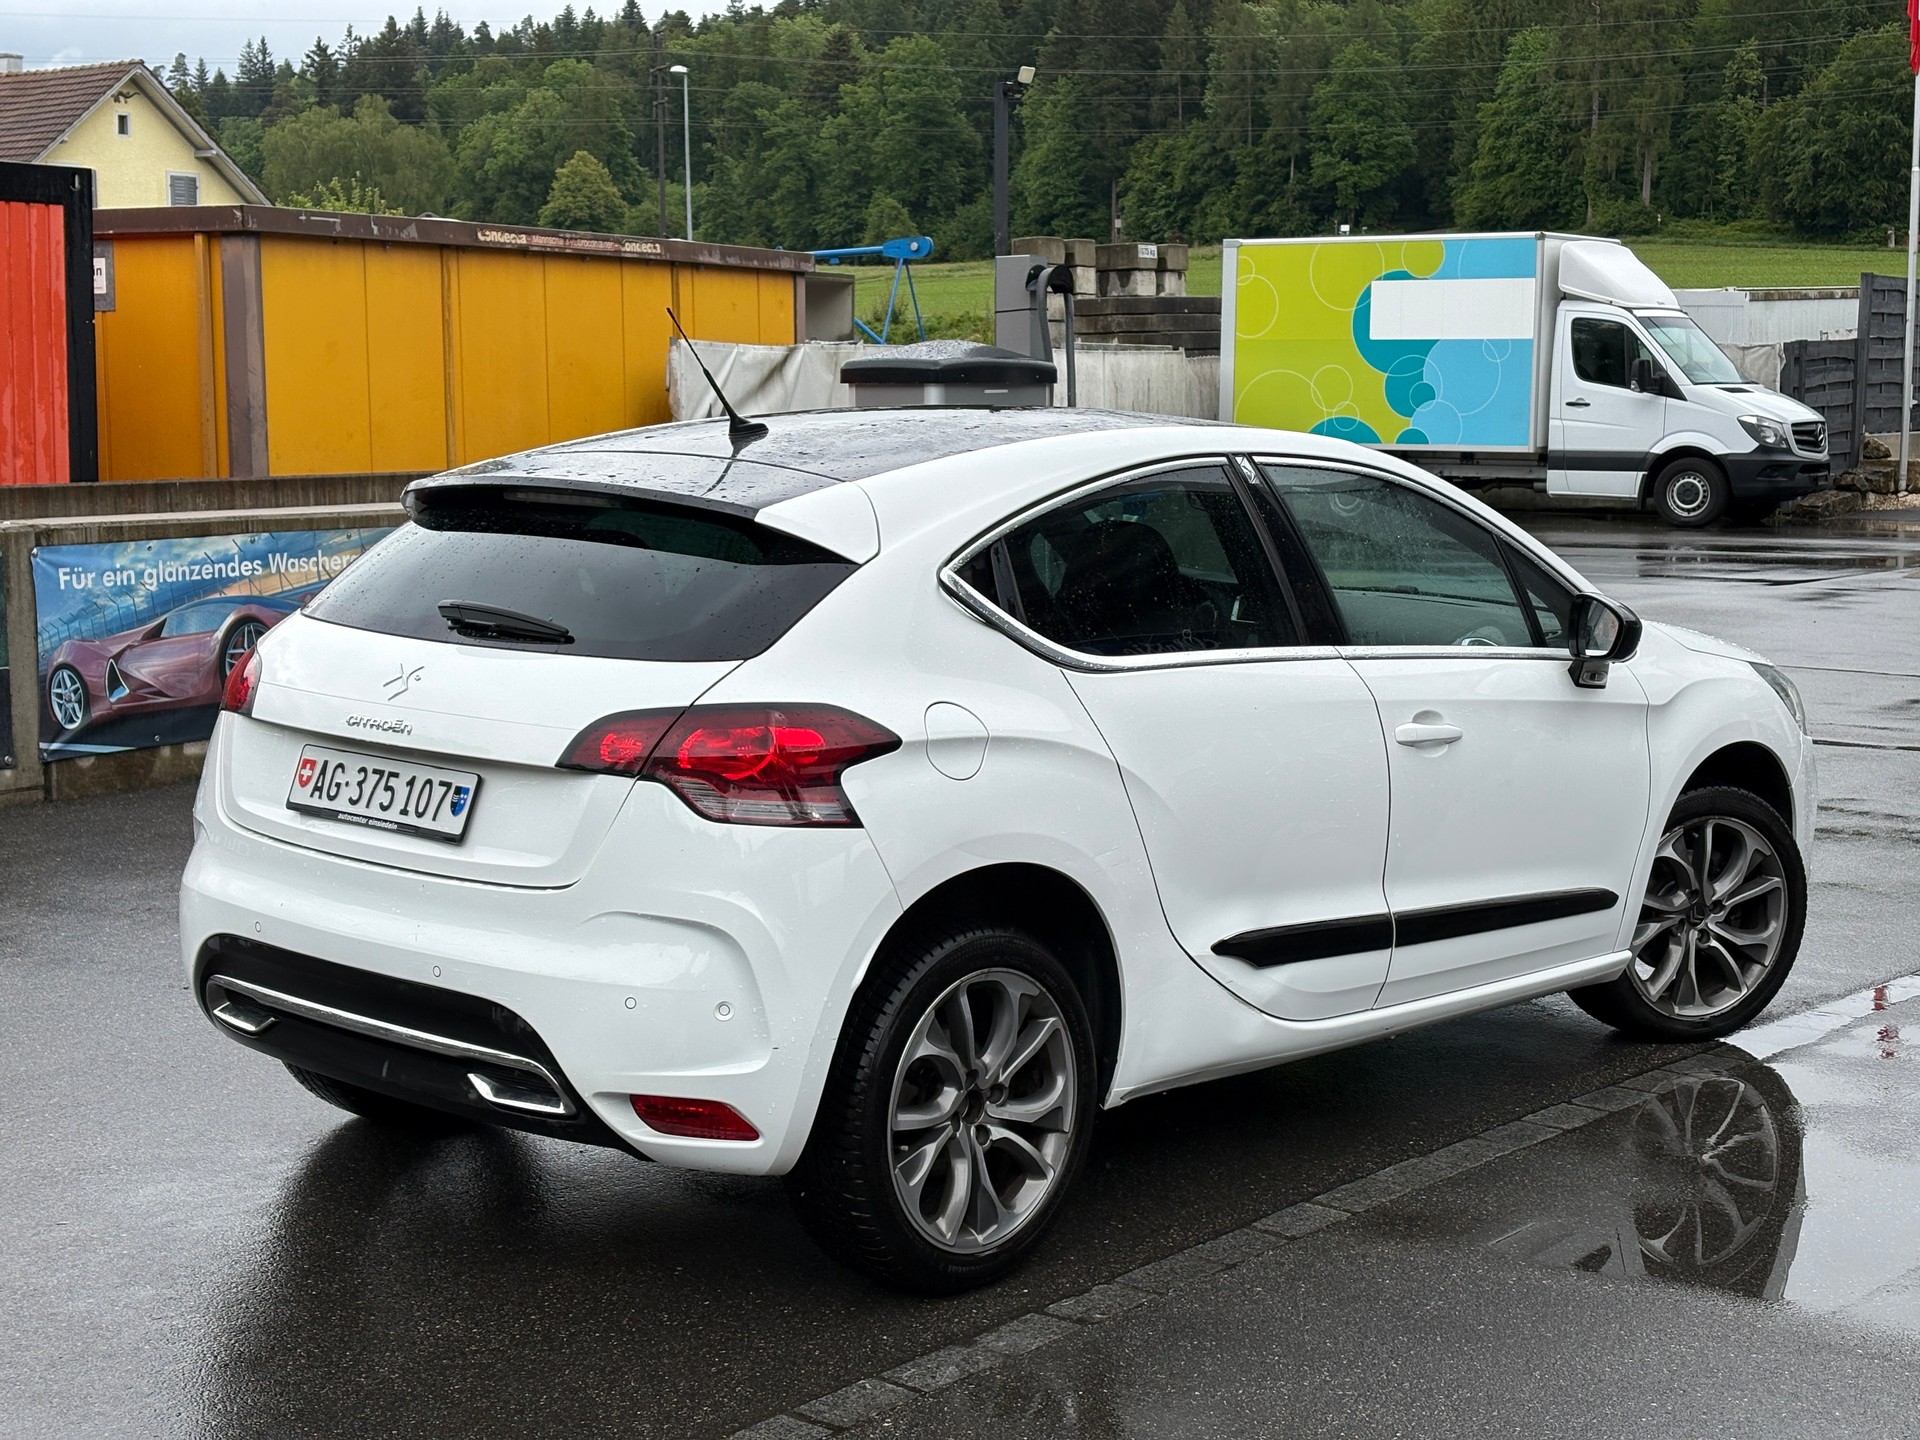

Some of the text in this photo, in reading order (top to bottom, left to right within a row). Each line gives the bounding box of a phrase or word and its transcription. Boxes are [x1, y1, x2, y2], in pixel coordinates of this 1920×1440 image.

[58, 566, 96, 590] Für
[102, 562, 136, 587] ein
[143, 554, 262, 591] glänzendes
[337, 812, 368, 824] autocenter
